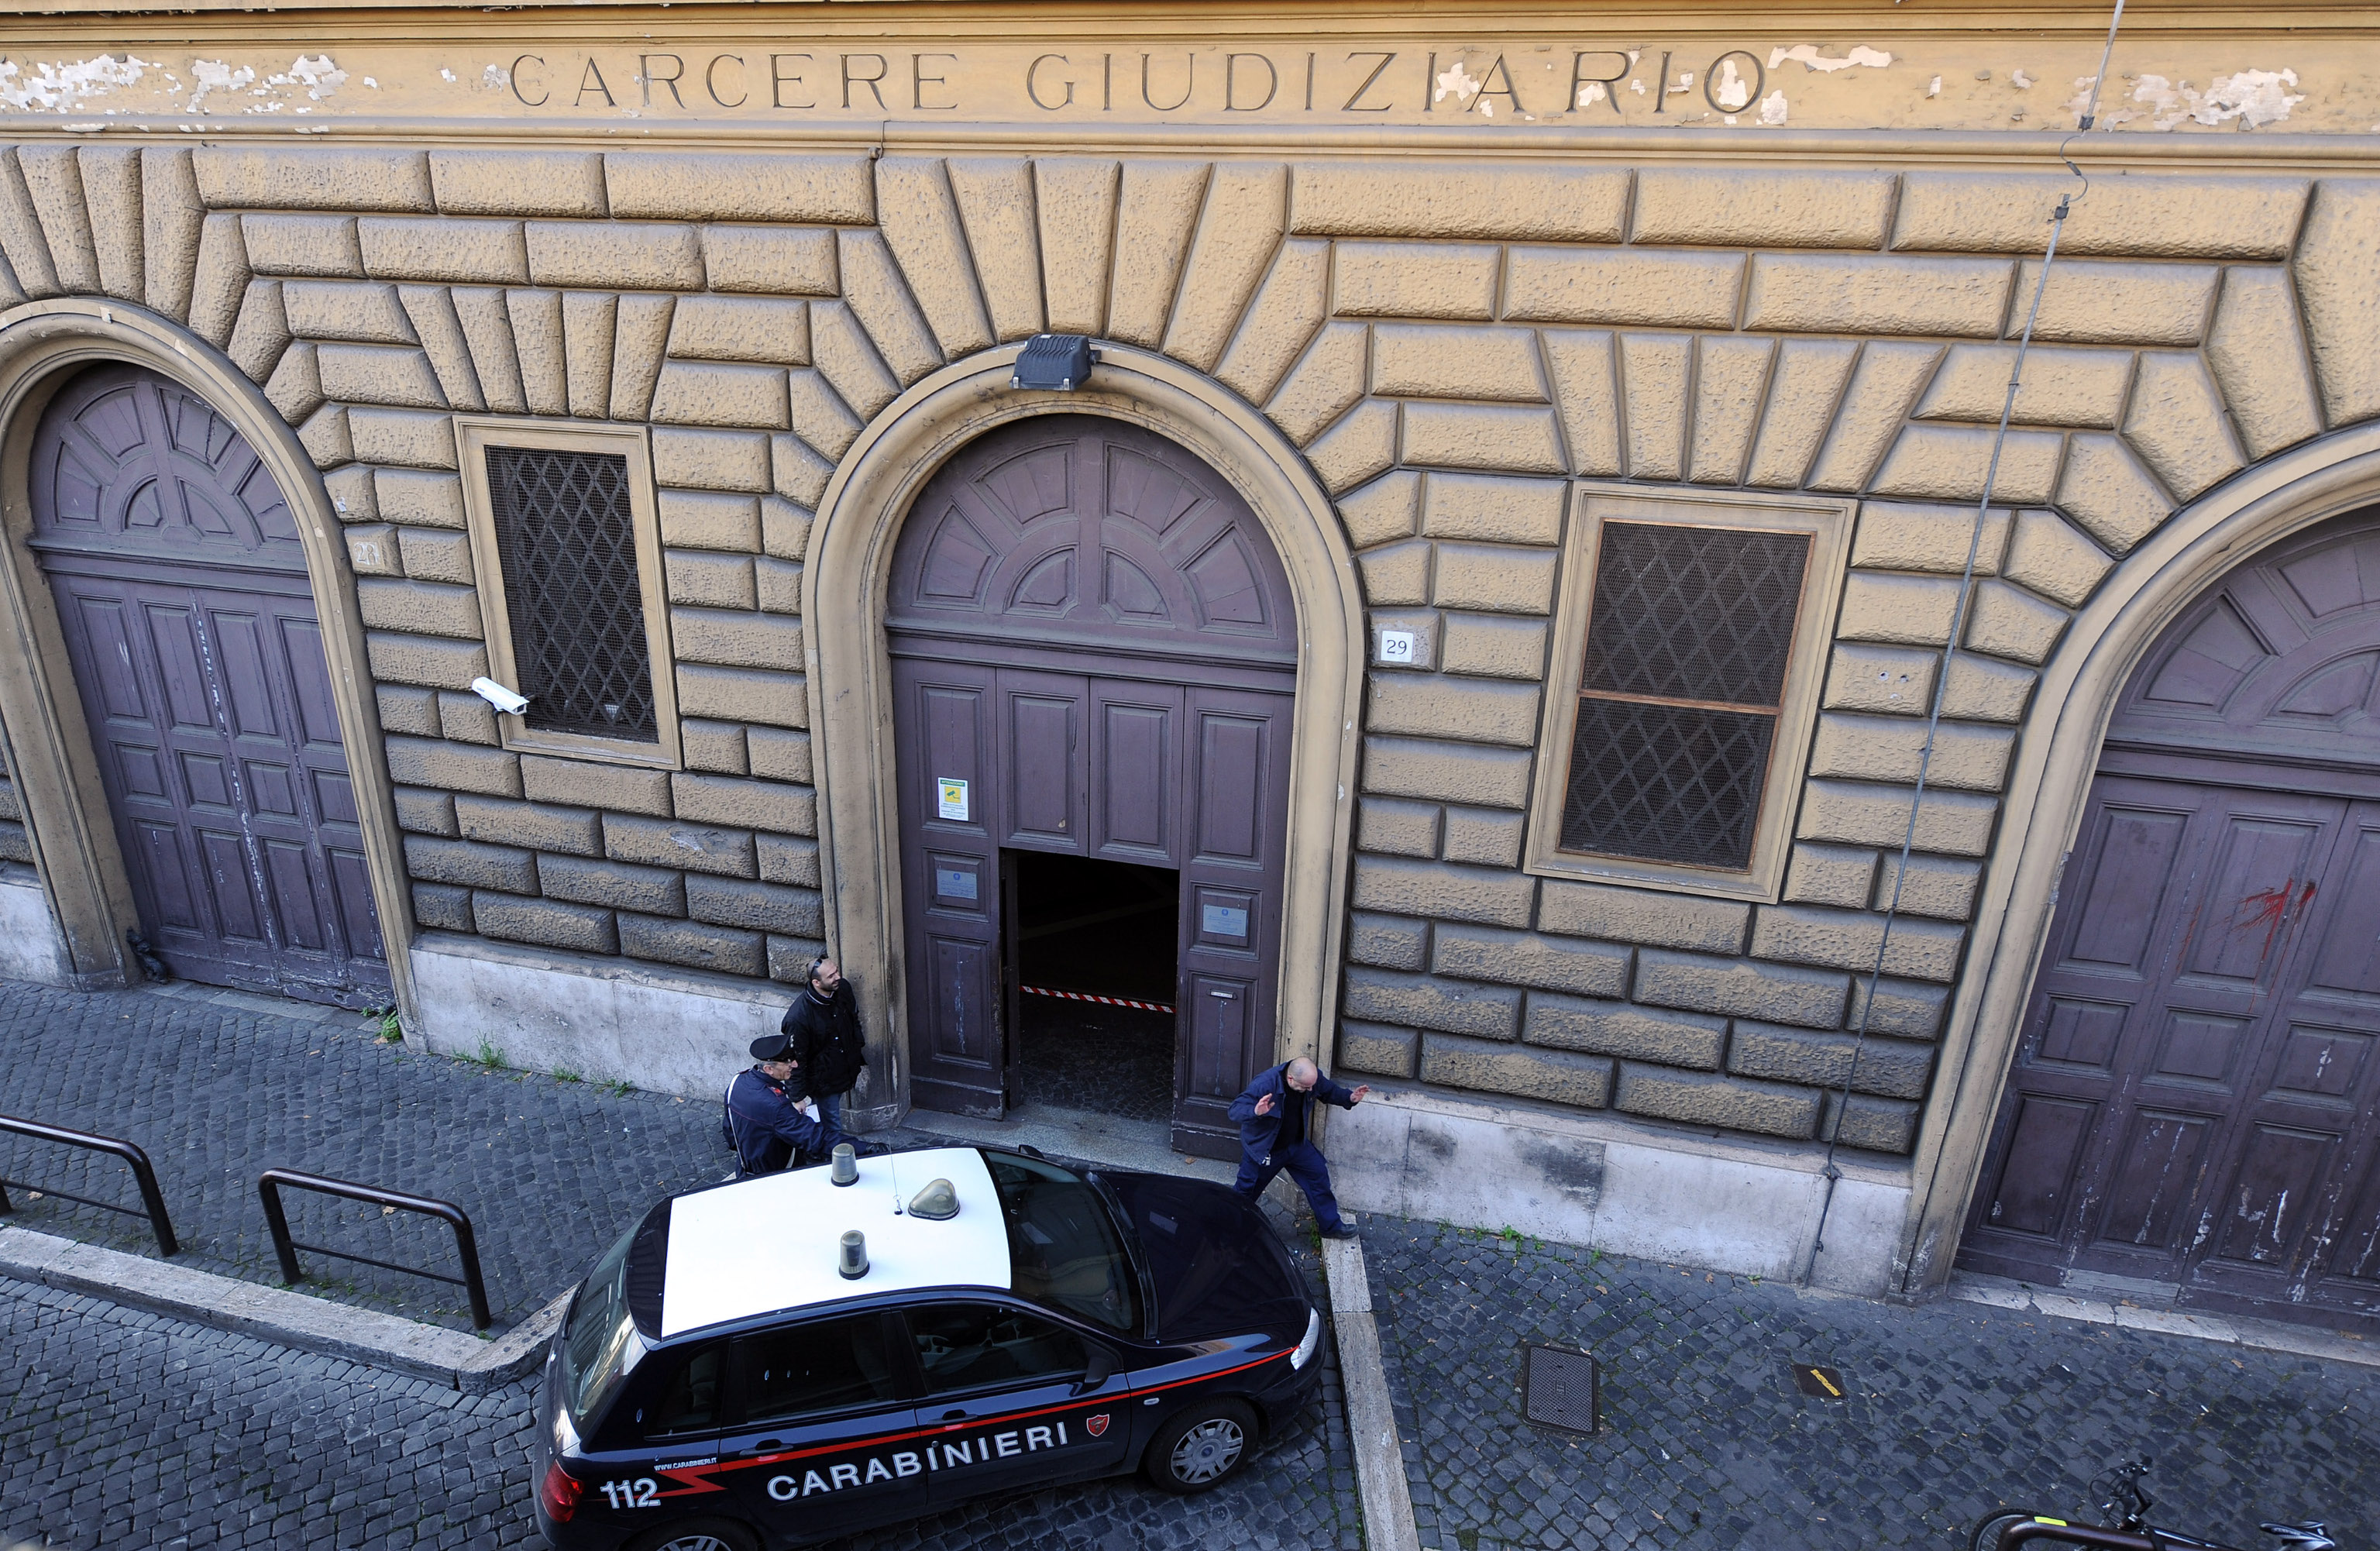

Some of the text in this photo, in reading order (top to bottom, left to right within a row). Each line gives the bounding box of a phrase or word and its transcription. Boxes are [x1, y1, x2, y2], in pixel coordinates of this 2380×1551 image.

[510, 50, 1766, 114] CARCERE GIUDIZIARIO
[355, 543, 377, 565] 28
[1387, 639, 1407, 655] 29
[767, 1422, 1068, 1501] CARABINIERI
[600, 1477, 661, 1508] 112
